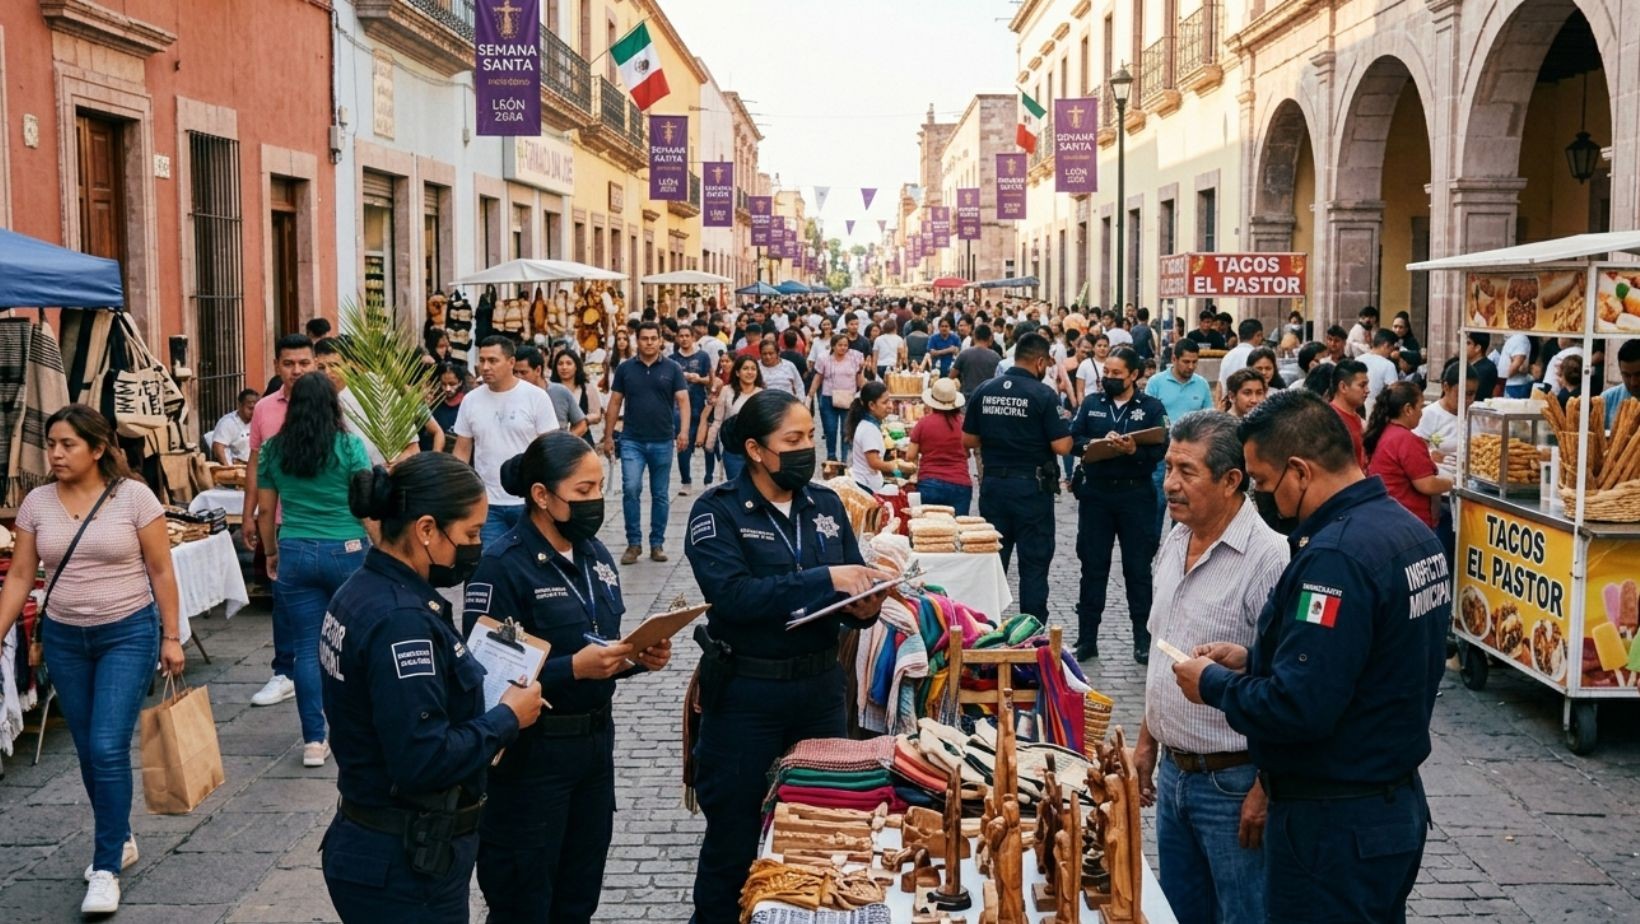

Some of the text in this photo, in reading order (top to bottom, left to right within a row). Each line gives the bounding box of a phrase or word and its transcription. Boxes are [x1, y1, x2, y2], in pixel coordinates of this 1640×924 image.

[478, 44, 537, 56] SEMANA
[483, 58, 534, 71] SANTA
[1215, 257, 1280, 273] TACOS
[1193, 277, 1217, 294] EL
[1223, 277, 1300, 294] PASTOR
[1486, 514, 1545, 565] TACOS
[1467, 546, 1563, 618] EL PASTOR
